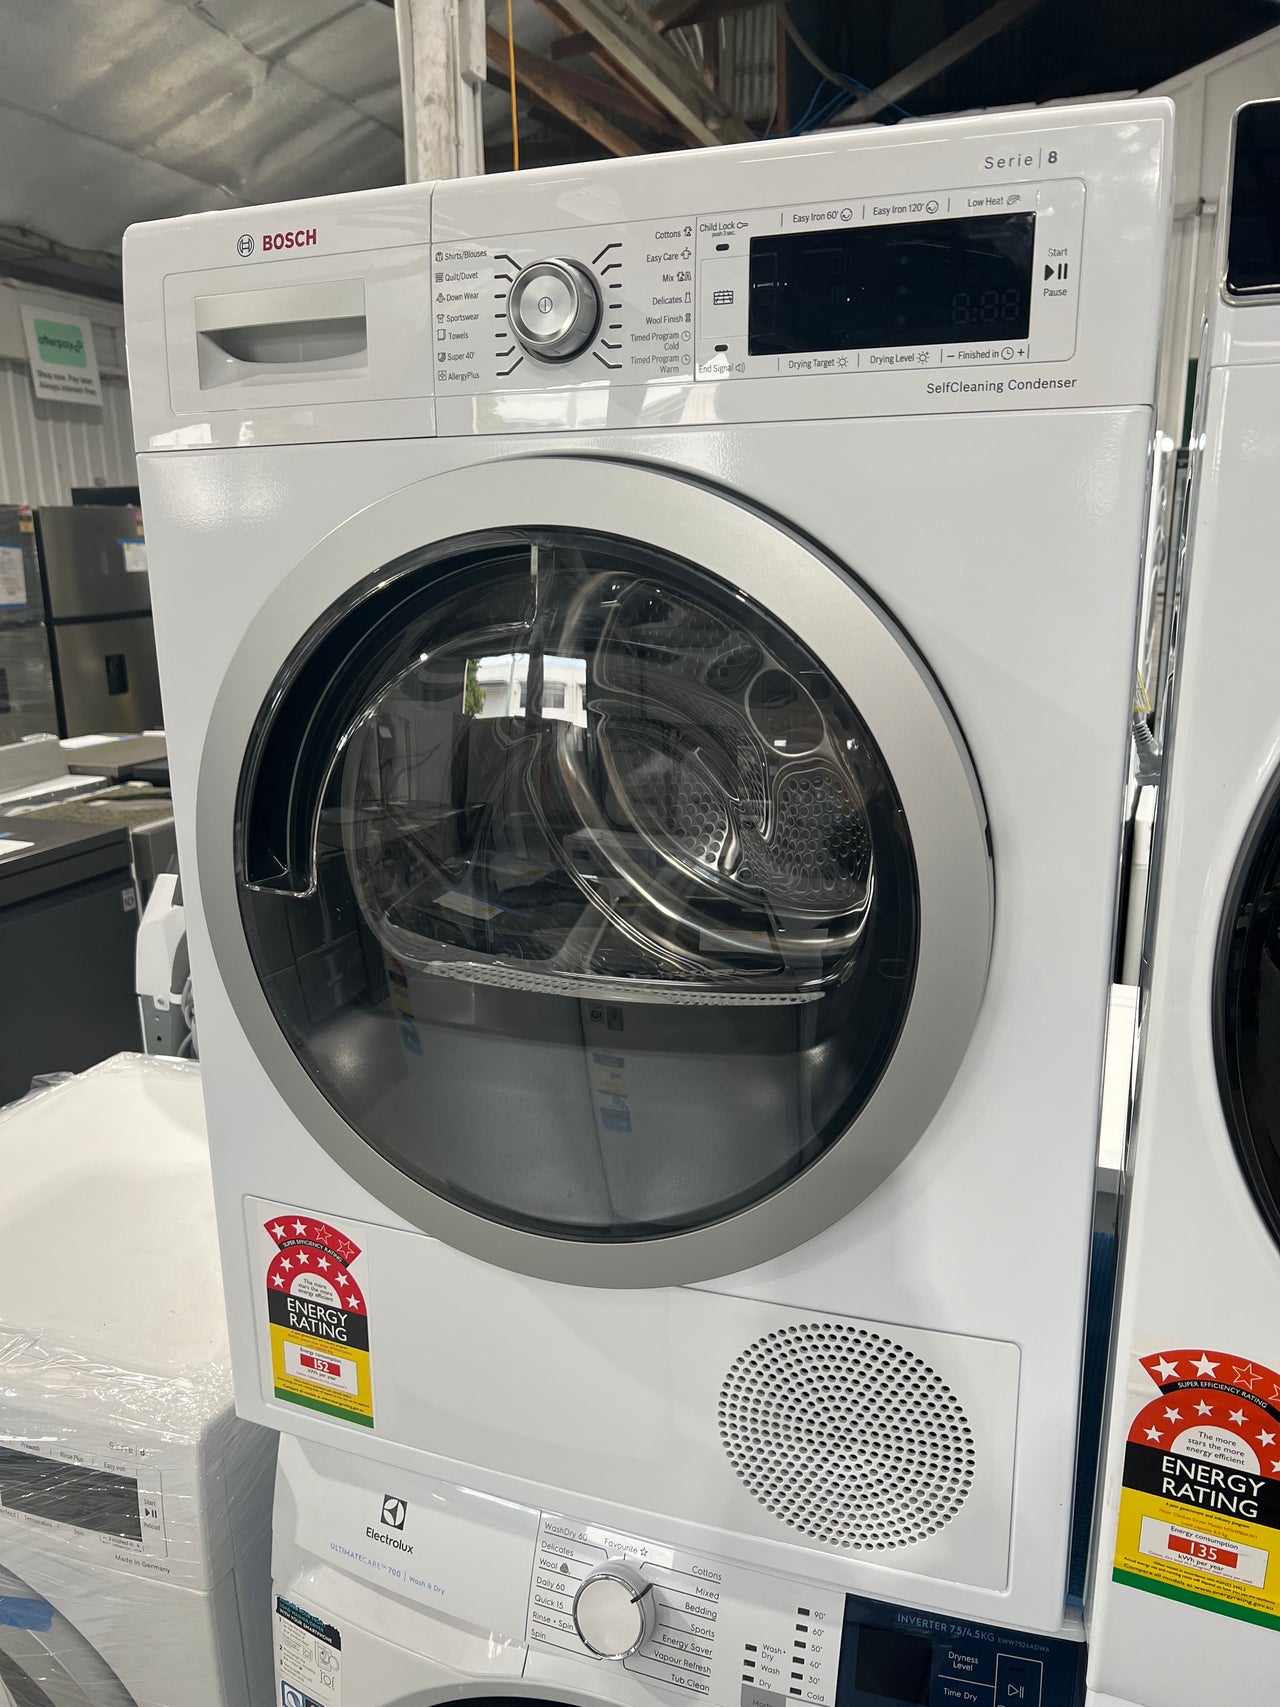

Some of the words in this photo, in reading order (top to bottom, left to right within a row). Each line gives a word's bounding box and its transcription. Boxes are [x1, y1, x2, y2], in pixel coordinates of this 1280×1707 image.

[984, 153, 1033, 169] Serie
[1047, 150, 1058, 164] 8
[968, 198, 984, 208] Low
[985, 196, 1003, 206] Heat
[793, 214, 809, 224] Easy
[811, 212, 825, 222] Iron
[873, 206, 890, 217] Easy
[892, 205, 907, 214] Iron
[700, 221, 717, 232] Child
[718, 221, 735, 231] Lock
[262, 228, 317, 251] BOSCH
[655, 230, 681, 240] Cottons
[444, 250, 487, 261] Shirts/Blouses
[646, 253, 662, 264] Easy
[663, 252, 679, 261] Care
[1048, 247, 1068, 257] Start
[444, 271, 478, 282] Quilt/Duvet
[662, 273, 674, 282] Mix
[446, 293, 463, 302] Down
[463, 292, 479, 300] Wear
[1043, 287, 1067, 297] Pause
[652, 296, 683, 306] Delicates
[446, 313, 480, 324] Sportswear
[645, 316, 663, 325] Wool
[663, 314, 684, 324] Finish
[448, 331, 469, 340] Towels
[630, 332, 651, 342] Timed
[651, 332, 680, 342] Program
[664, 342, 680, 351] Cold
[447, 353, 464, 362] Super
[630, 355, 651, 365] Timed
[651, 354, 680, 365] Program
[870, 354, 894, 366] Drying
[895, 352, 915, 363] Level
[958, 349, 991, 360] Finished
[991, 349, 999, 358] in
[660, 365, 680, 374] Warm
[699, 365, 712, 374] End
[713, 363, 734, 375] Signal
[788, 360, 811, 371] Drying
[813, 358, 835, 369] Target
[448, 371, 480, 382] AllergyPlus
[926, 380, 1004, 394] SelfCleaning
[1007, 377, 1078, 391] Condenser
[296, 1239, 324, 1250] EFFICIENCY
[323, 1246, 343, 1263] RATING
[303, 1278, 313, 1286] The
[314, 1282, 327, 1290] more
[298, 1288, 314, 1298] energy
[286, 1296, 348, 1328] ENERGY
[289, 1313, 348, 1343] RATING
[313, 1358, 330, 1373] 152
[1177, 1380, 1199, 1389] SUPER
[1200, 1381, 1241, 1395] EFFICIENCY
[1241, 1391, 1269, 1409] RATING
[1198, 1430, 1213, 1441] The
[1215, 1437, 1237, 1447] more
[1187, 1438, 1206, 1447] stars
[1208, 1442, 1221, 1451] the
[1223, 1447, 1245, 1457] more
[1186, 1446, 1212, 1458] energy
[1214, 1452, 1245, 1466] efficient
[1161, 1454, 1266, 1498] ENERGY
[1161, 1477, 1258, 1519] RATING
[544, 1522, 577, 1539] WashDry
[578, 1532, 588, 1542] 60
[1170, 1525, 1194, 1538] Energy
[1194, 1531, 1239, 1551] consumption
[366, 1526, 414, 1555] Electrolux
[604, 1537, 638, 1554] Favourite
[541, 1540, 574, 1557] Delicates
[1190, 1541, 1218, 1561] 135
[114, 1554, 133, 1564] Made
[141, 1560, 171, 1574] Germany
[539, 1557, 558, 1570] Wool
[1177, 1553, 1195, 1563] kWh
[1196, 1558, 1208, 1567] per
[1209, 1562, 1225, 1572] year
[691, 1565, 722, 1581] Cottons
[1123, 1563, 1153, 1575] Compare
[1162, 1576, 1185, 1586] models
[388, 1566, 401, 1578] 700
[409, 1575, 426, 1587] Wash
[433, 1584, 446, 1596] Dry
[536, 1576, 555, 1589] Daily
[555, 1583, 566, 1592] 60
[695, 1586, 720, 1600] Mixed
[534, 1594, 555, 1607] Quick
[556, 1600, 564, 1610] 15
[685, 1602, 717, 1620] Bedding
[532, 1611, 551, 1623] Rinse
[558, 1619, 574, 1631] Spin
[897, 1613, 947, 1633] INVERTER
[950, 1624, 995, 1642] 7.5/4.5KG
[530, 1628, 546, 1640] Spin
[690, 1623, 715, 1638] Sports
[662, 1634, 689, 1650] Energy
[690, 1643, 713, 1656] Saver
[762, 1643, 782, 1655] Wash
[654, 1649, 682, 1664] Vapour
[683, 1659, 712, 1674] Refresh
[761, 1651, 774, 1662] Dry
[948, 1651, 979, 1665] Dryness
[760, 1664, 780, 1675] Wash
[953, 1660, 973, 1671] Level
[671, 1673, 685, 1685] Tub
[687, 1678, 710, 1692] Clean
[759, 1678, 772, 1690] Dry
[806, 1691, 825, 1702] Cold
[943, 1687, 962, 1698] Time
[963, 1691, 978, 1702] Dry
